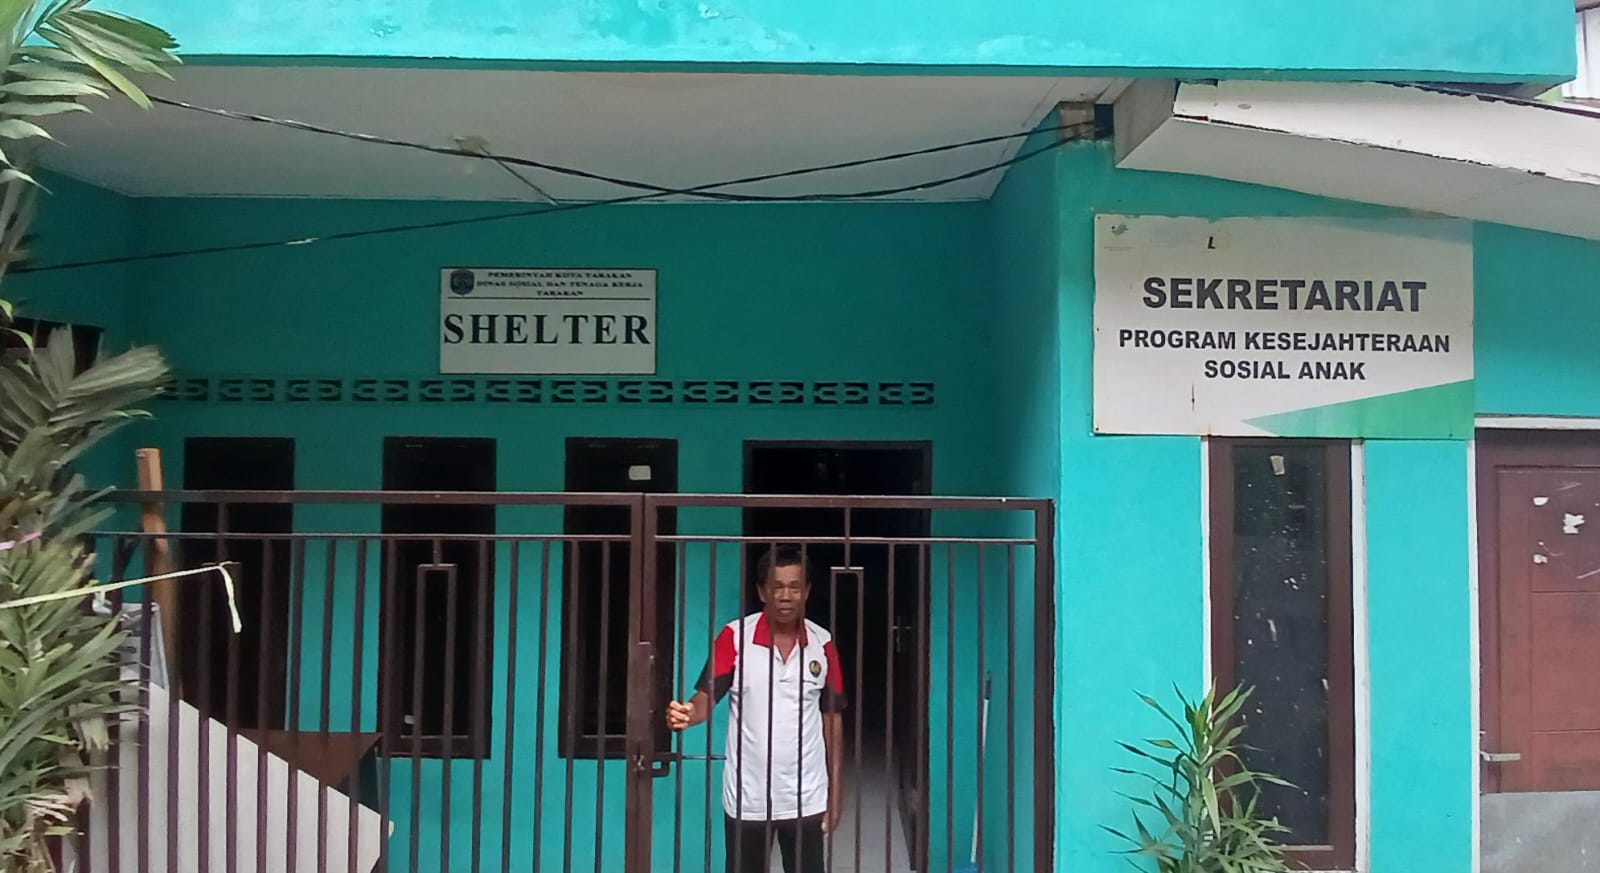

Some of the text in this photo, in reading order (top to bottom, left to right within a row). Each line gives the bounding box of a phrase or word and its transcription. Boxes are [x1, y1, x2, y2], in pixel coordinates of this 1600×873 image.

[1143, 277, 1427, 312] SEKRETARIAT
[444, 313, 650, 344] SHELTER
[1119, 328, 1450, 353] PROGRAM KESEJAHTERAAN
[1204, 360, 1365, 380] SOSIAL ANAK
